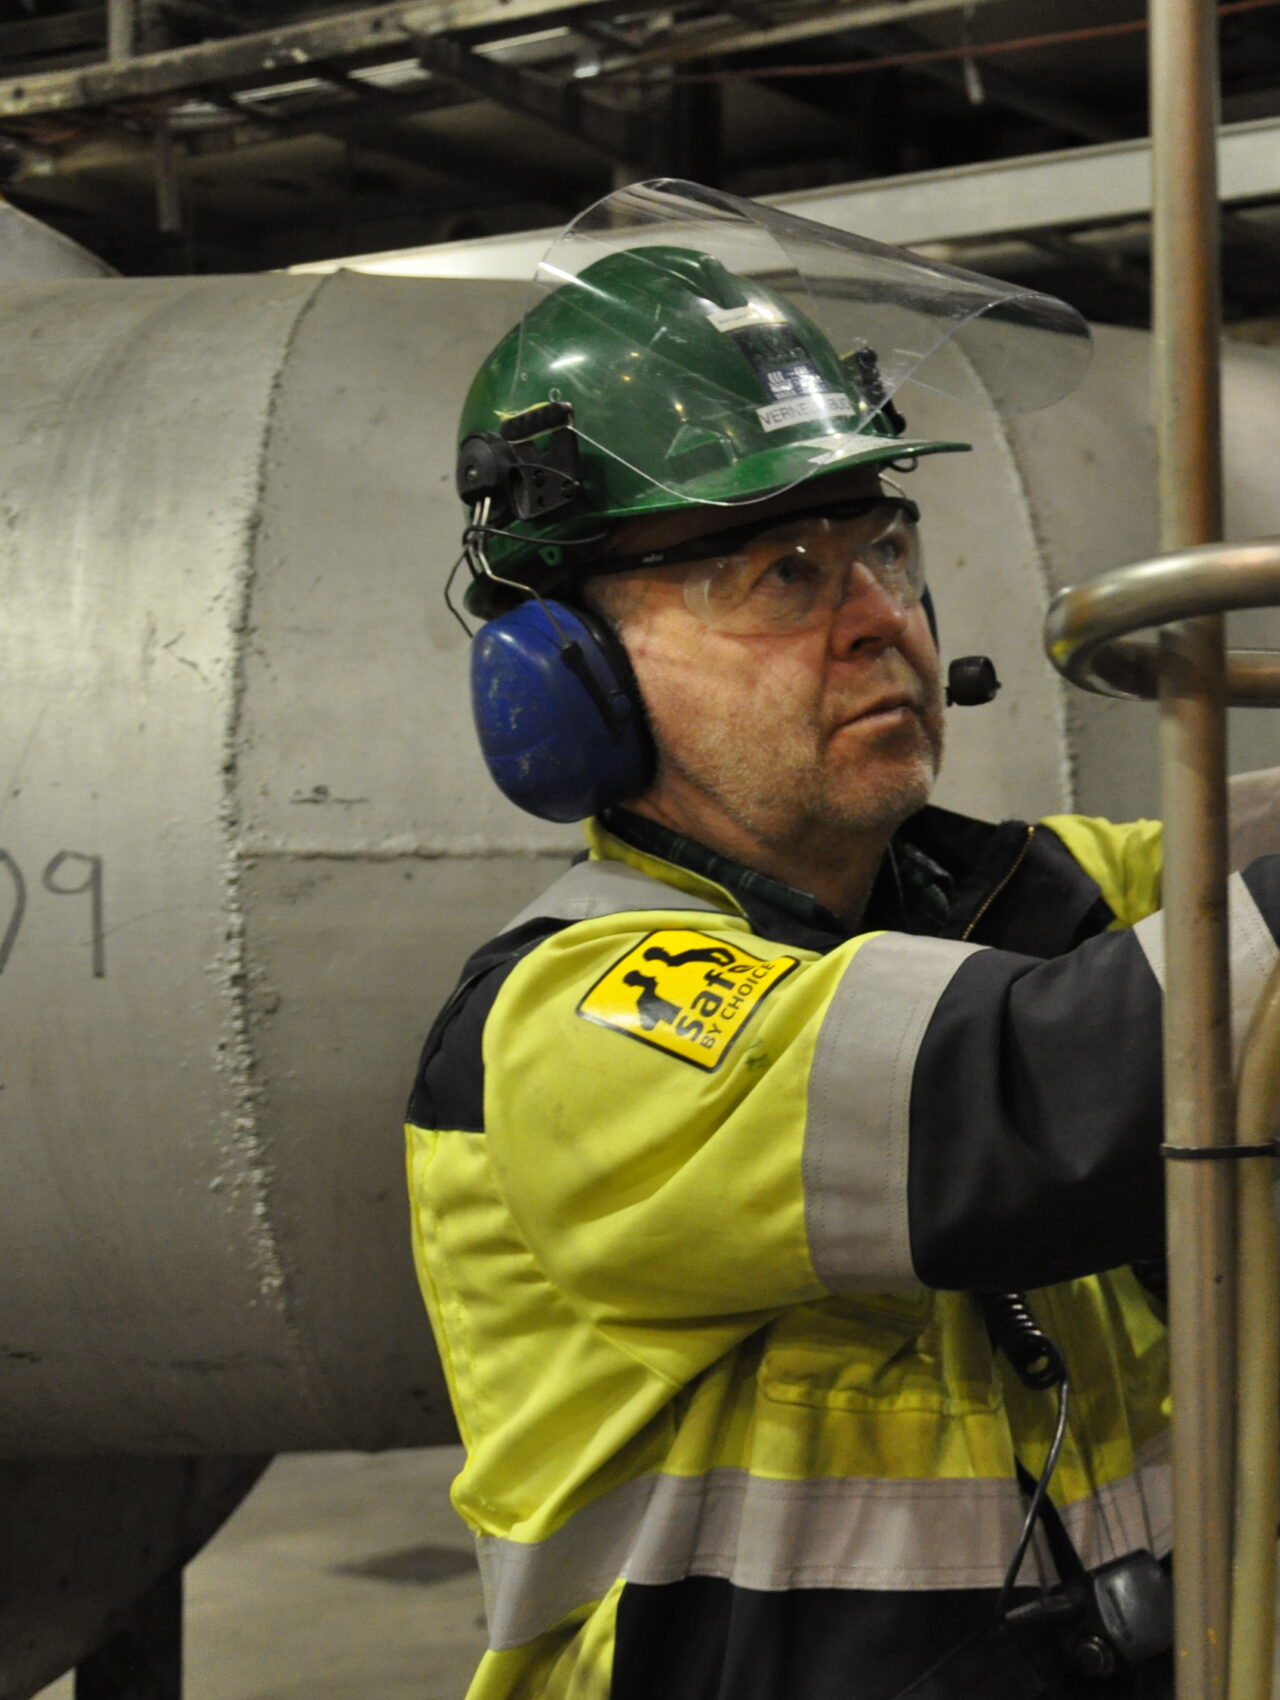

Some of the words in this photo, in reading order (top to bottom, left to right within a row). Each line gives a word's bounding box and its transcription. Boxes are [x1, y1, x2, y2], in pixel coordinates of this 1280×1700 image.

[675, 964, 753, 1042] safe
[700, 1023, 723, 1050] BY
[720, 962, 776, 1020] CHOICE
